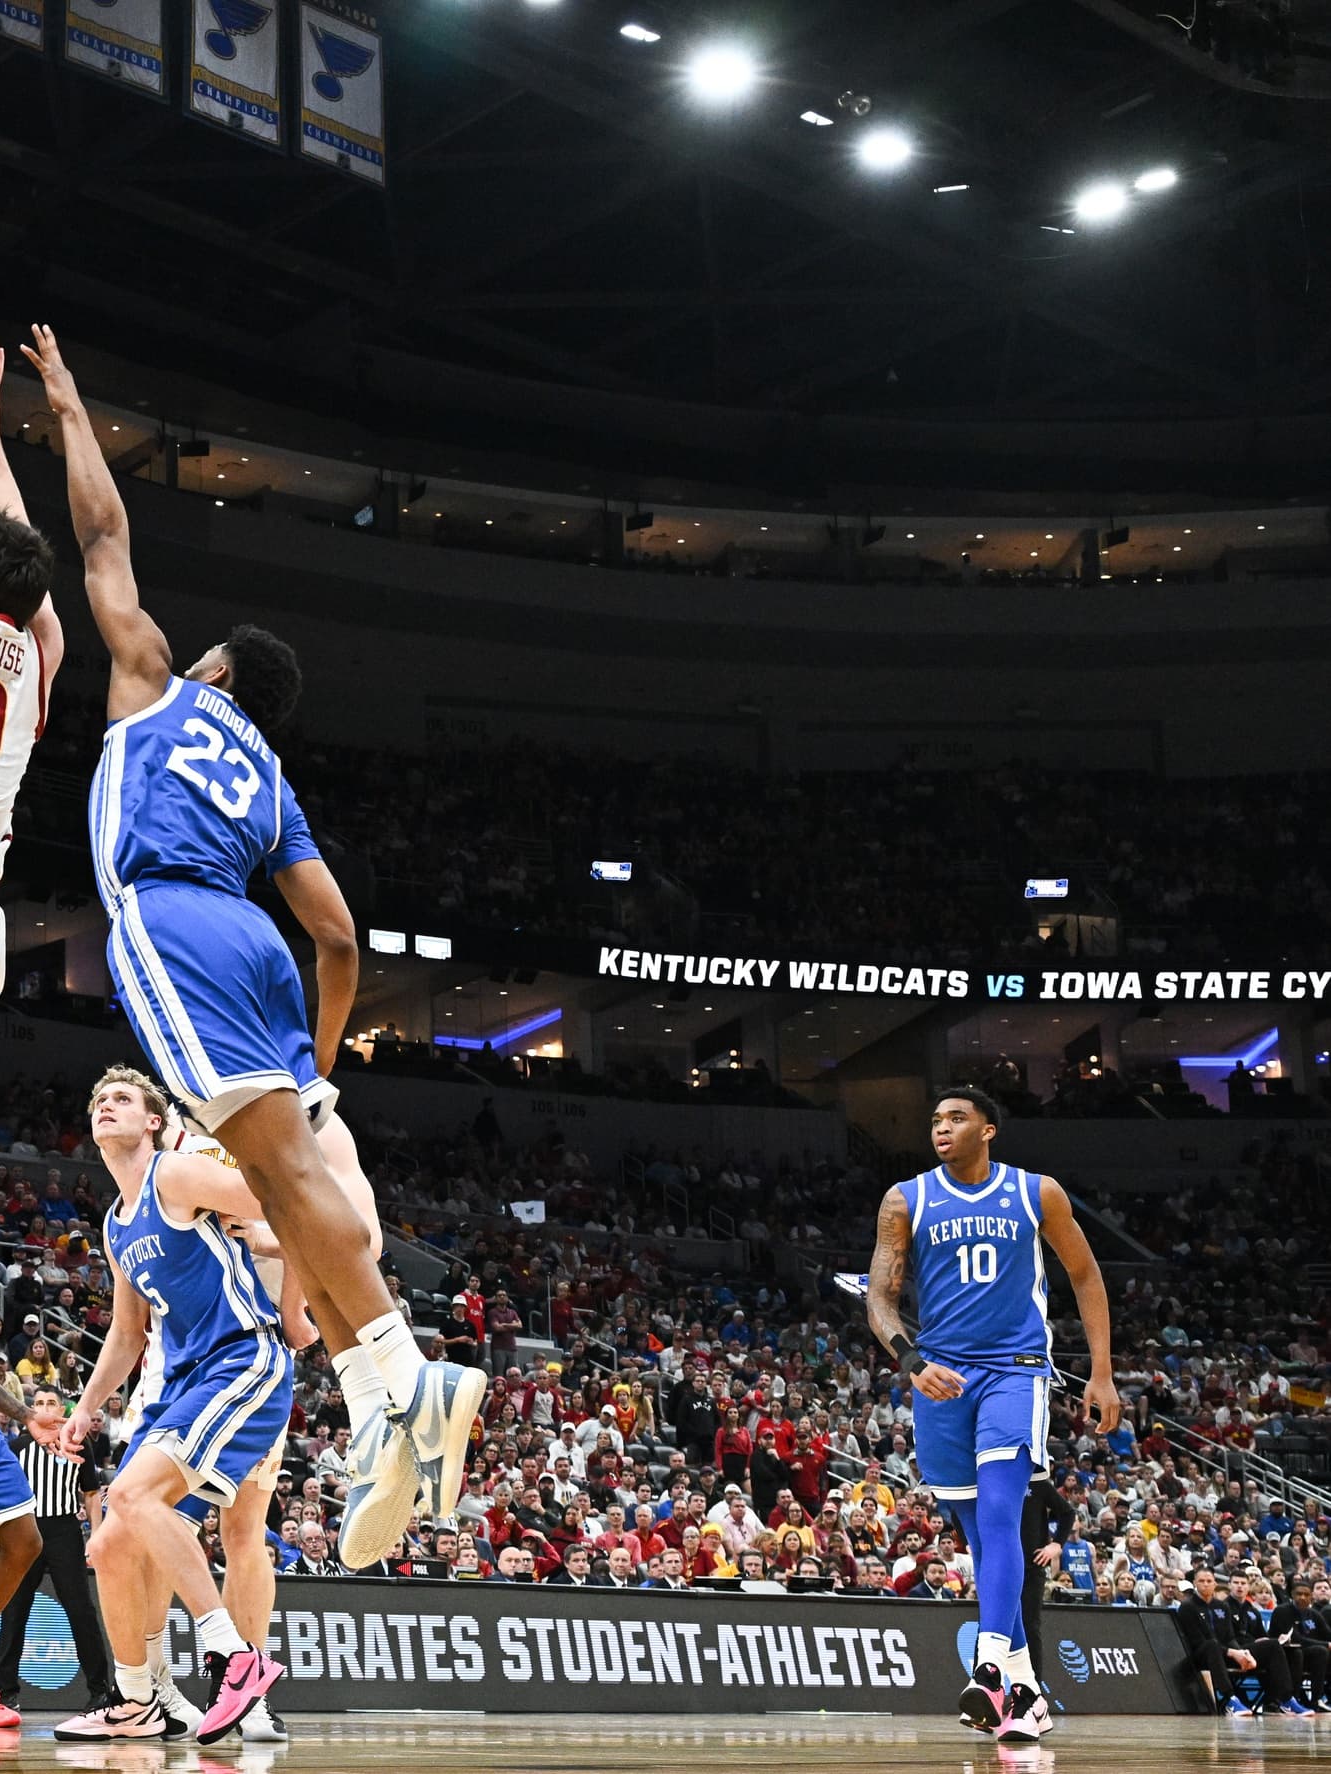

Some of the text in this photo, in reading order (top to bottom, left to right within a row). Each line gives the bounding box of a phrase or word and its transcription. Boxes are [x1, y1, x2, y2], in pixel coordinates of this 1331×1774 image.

[73, 31, 159, 71] CHAMPIONS
[306, 125, 381, 164] CHAMPIONS
[166, 718, 261, 819] 23
[599, 947, 781, 987] KENTUCKY
[790, 962, 968, 997] WILDCATS
[986, 975, 1025, 998] VS
[1040, 972, 1142, 998] IOWA
[1155, 972, 1270, 998] STATE
[929, 1216, 1019, 1245] KENTUCKY
[956, 1243, 997, 1284] 10
[136, 1271, 170, 1317] 5
[163, 1607, 915, 1688] CBRATES STUDENT-ATHLETES
[1091, 1647, 1139, 1676] AT&T
